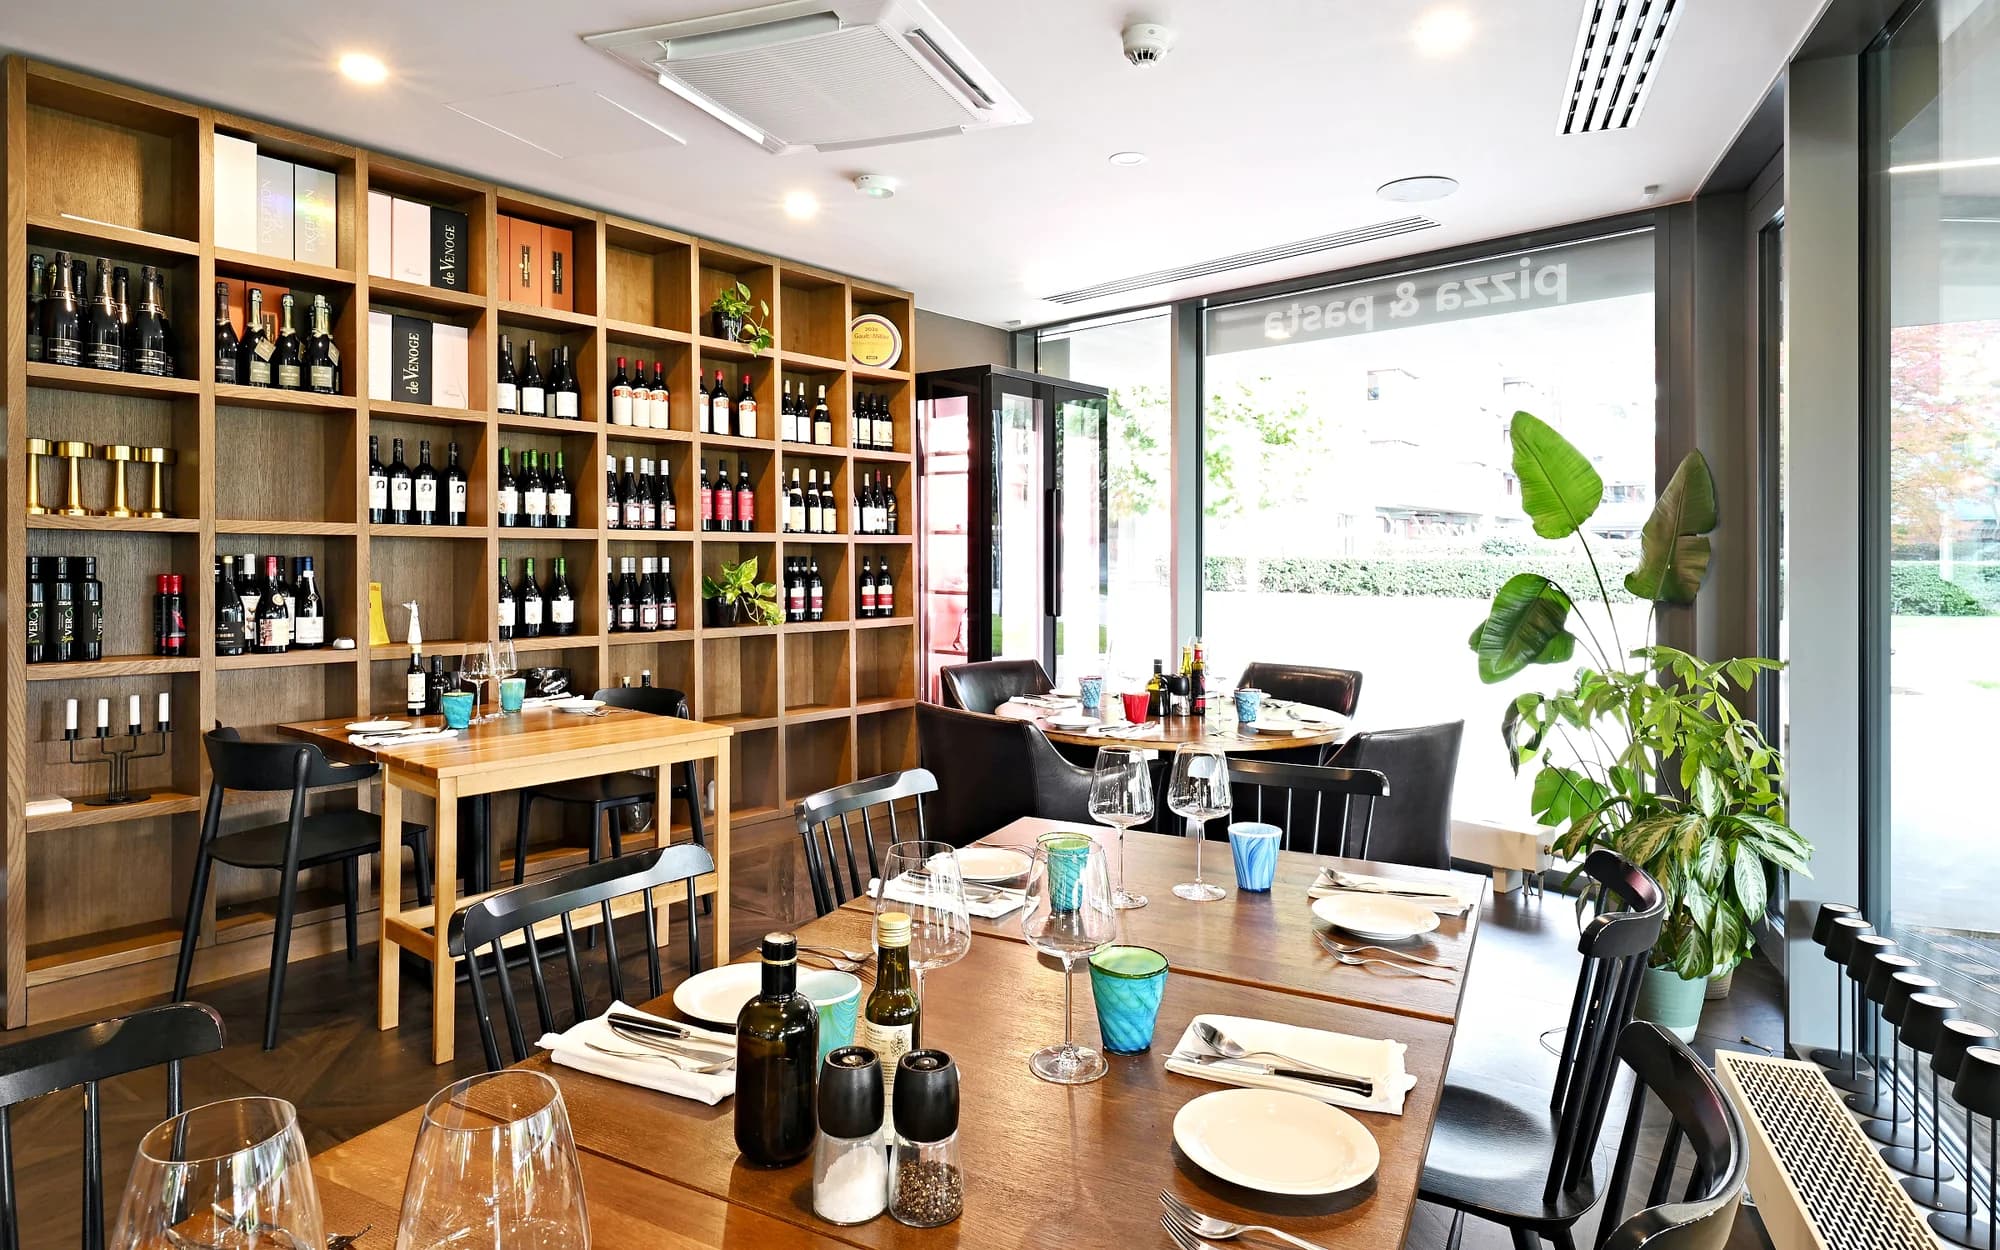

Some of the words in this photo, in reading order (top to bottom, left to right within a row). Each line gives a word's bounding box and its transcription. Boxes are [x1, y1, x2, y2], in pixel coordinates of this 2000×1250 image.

[439, 224, 455, 271] VENOGE
[442, 271, 455, 285] de
[402, 332, 420, 380] VENOGE
[405, 380, 419, 395] de
